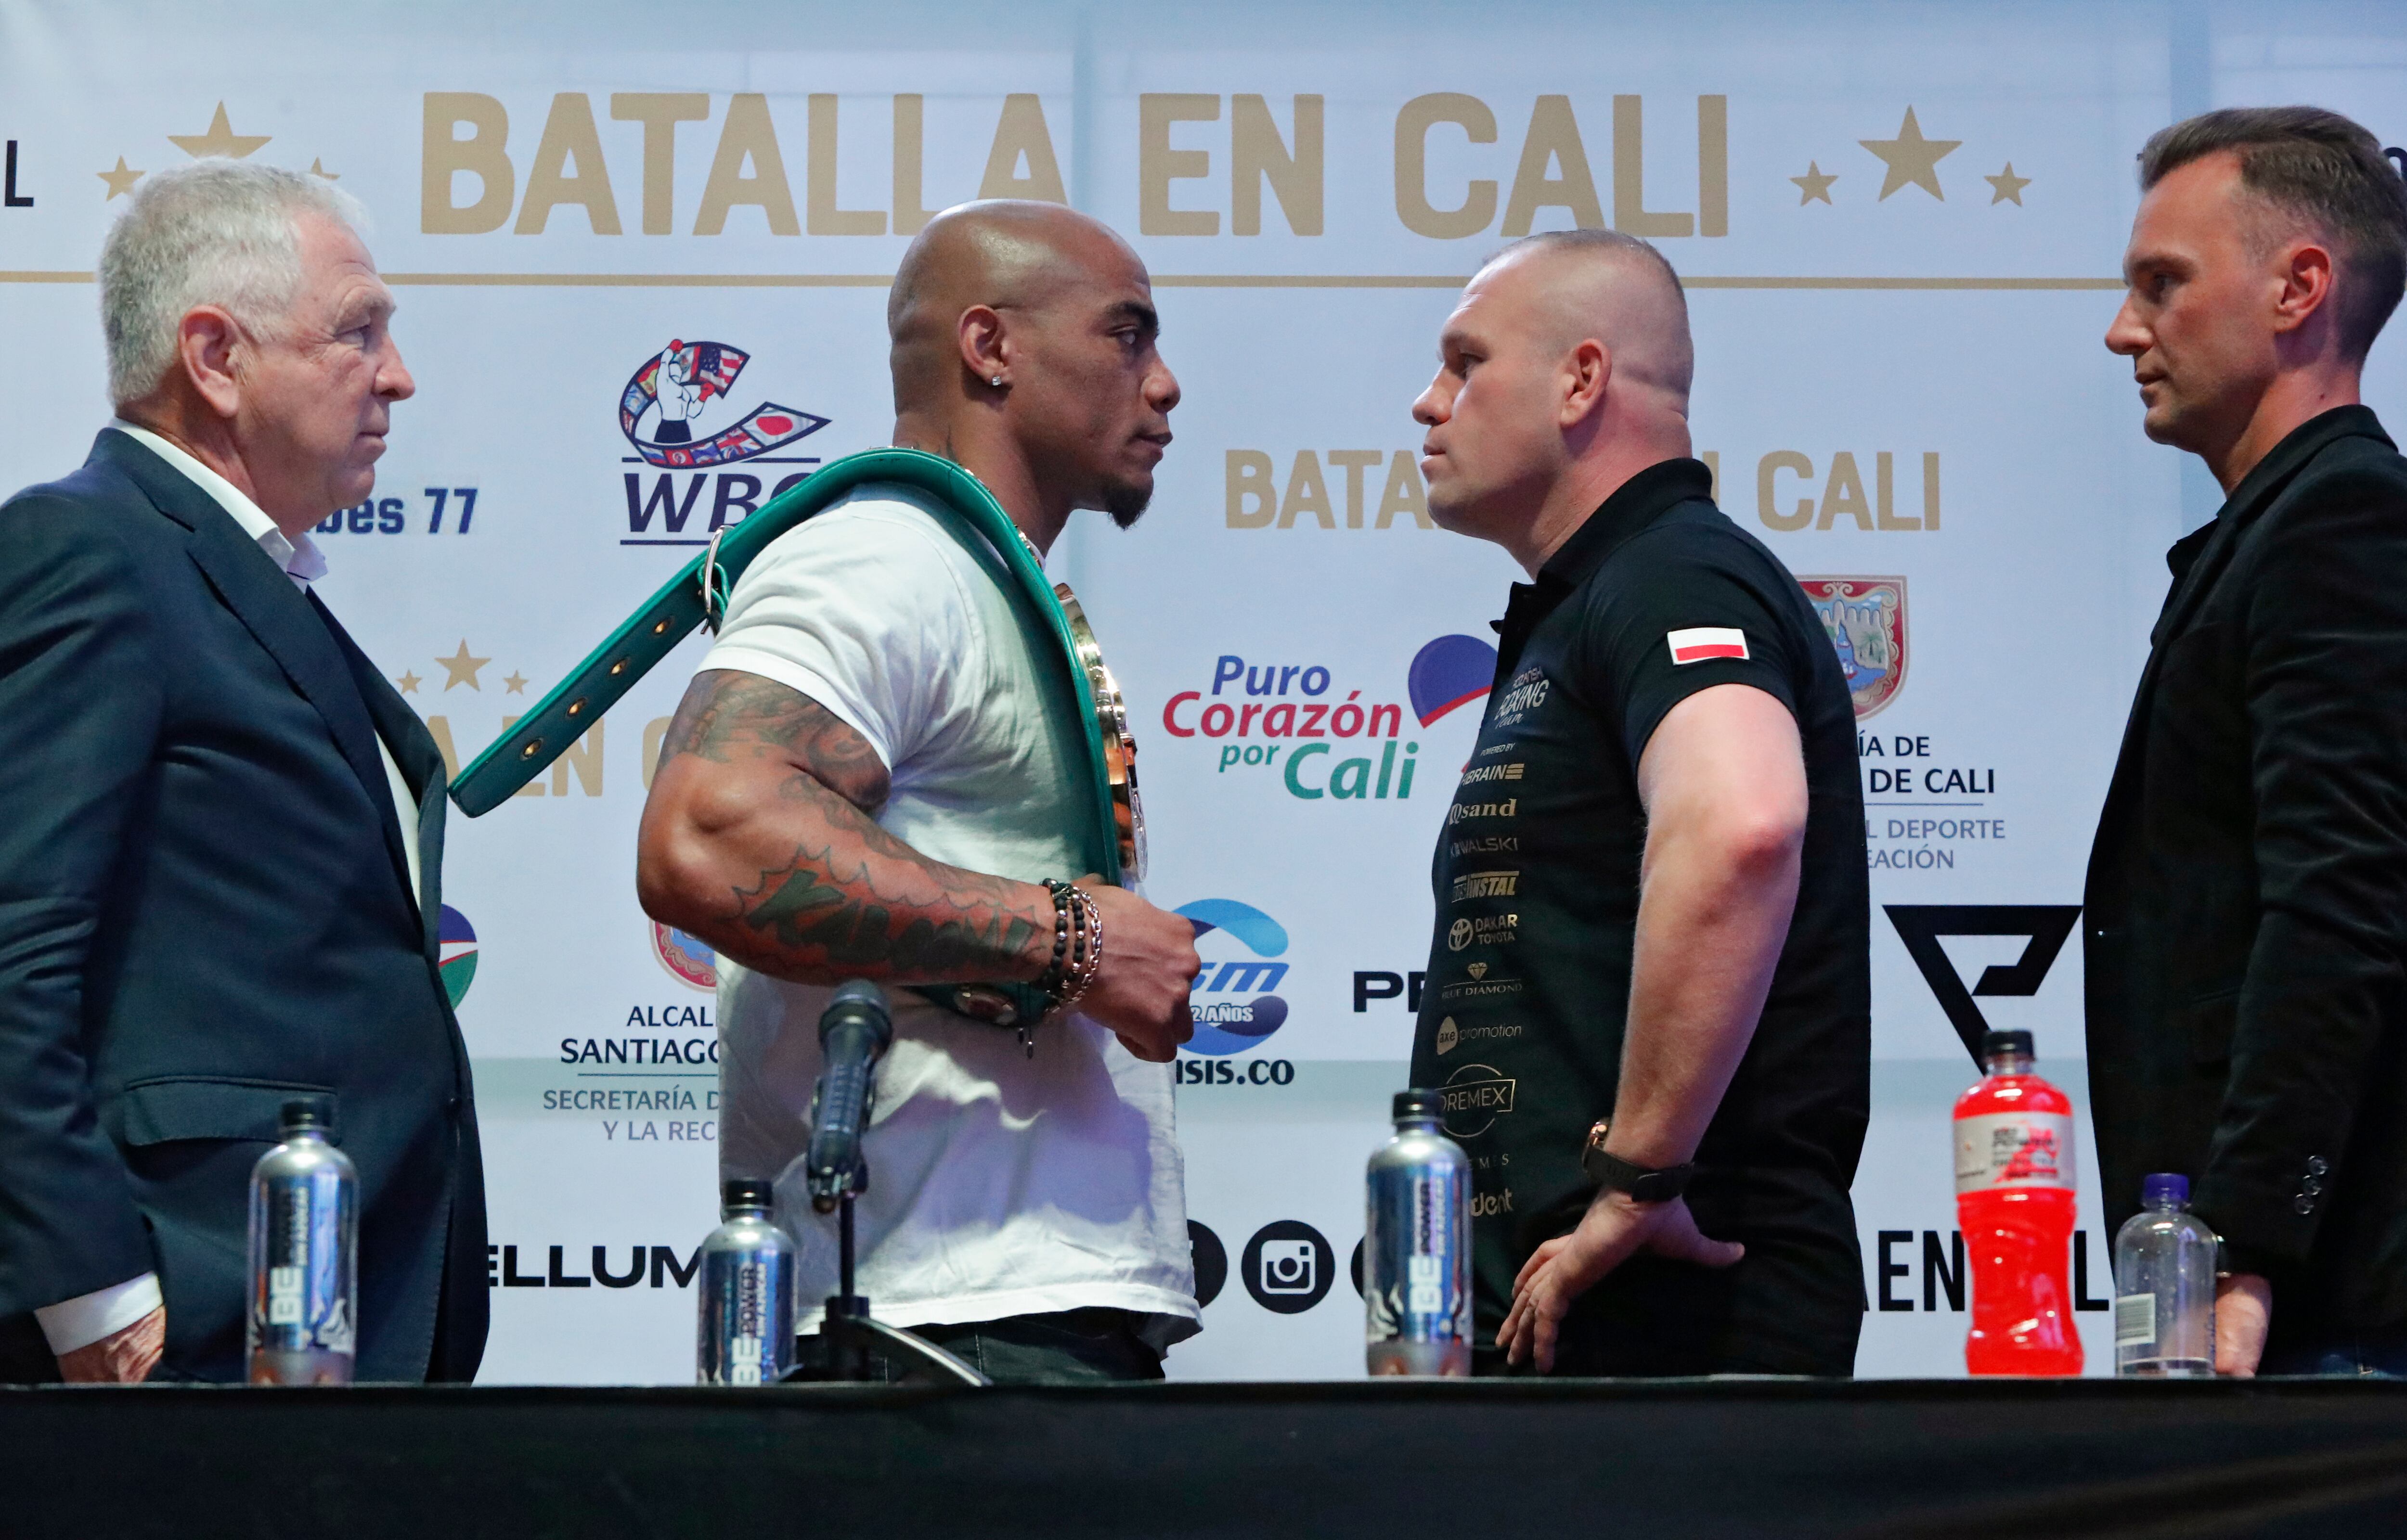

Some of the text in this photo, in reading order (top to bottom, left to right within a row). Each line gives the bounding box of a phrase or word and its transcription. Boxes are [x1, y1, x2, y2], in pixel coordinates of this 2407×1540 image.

[420, 91, 1728, 239] BATALLA EN CALI
[1225, 449, 1442, 529] BATA
[1757, 449, 1941, 531] CALI
[424, 488, 478, 535] 77
[1211, 655, 1331, 696] Puro
[1163, 690, 1401, 738] Corazón
[1895, 736, 1930, 757] DE
[1218, 741, 1419, 799] por Cali
[1870, 768, 1994, 794] DE CALI
[1888, 820, 2006, 839] DEPORTE
[1475, 913, 1518, 933] DAKAR
[1477, 931, 1515, 945] TOYOTA
[1465, 983, 1523, 996] DIAMOND
[626, 1006, 717, 1027] ALCAL
[1205, 1003, 1254, 1023] AÑOS
[1439, 1022, 1522, 1043] axe promotion
[543, 1084, 697, 1111] SECRETARÍA
[603, 1121, 619, 1141] Y
[628, 1121, 659, 1141] LA
